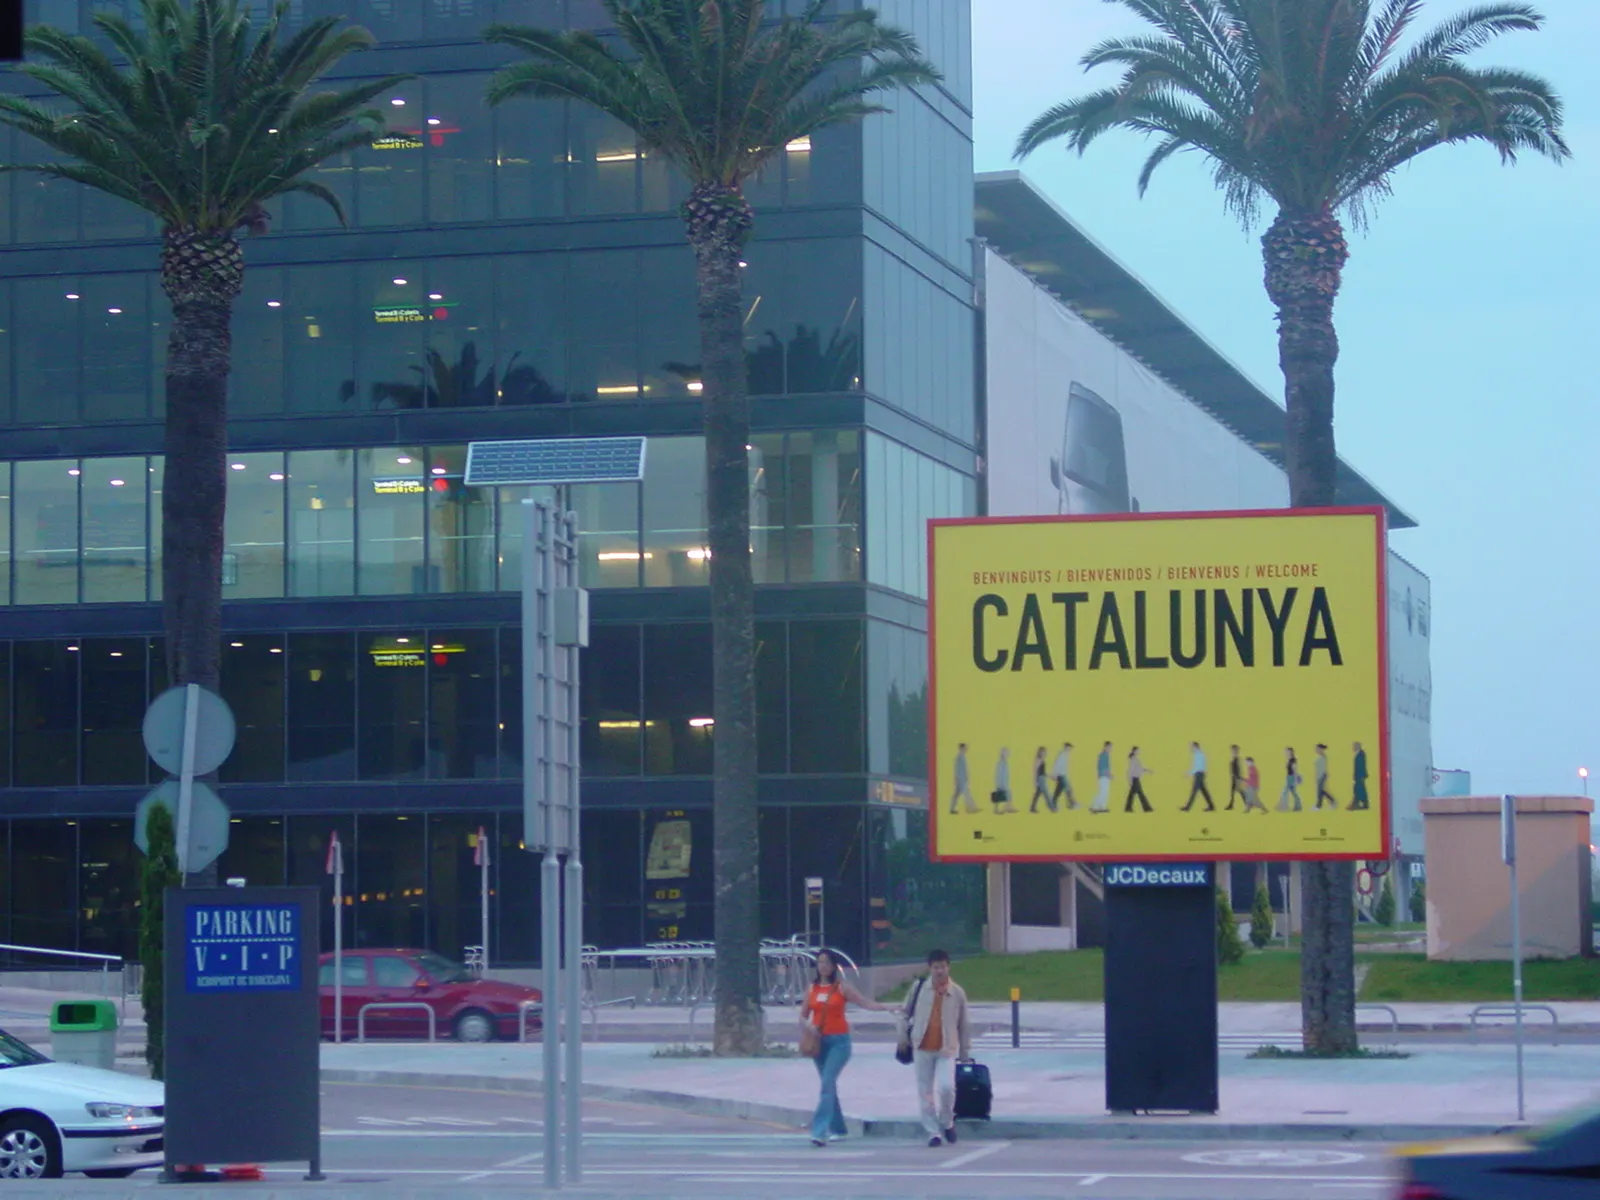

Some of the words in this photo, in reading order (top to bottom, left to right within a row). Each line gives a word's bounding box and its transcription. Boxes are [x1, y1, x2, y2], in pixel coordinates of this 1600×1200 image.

[973, 570, 1052, 585] BENVINGUTS
[1066, 567, 1153, 583] BIENVENIDOS
[1167, 565, 1240, 580] BIENVENUS
[1255, 563, 1319, 578] WELCOME
[972, 586, 1344, 673] CATALUNYA
[1107, 866, 1207, 884] JCDecaux
[196, 909, 292, 936] PARKING
